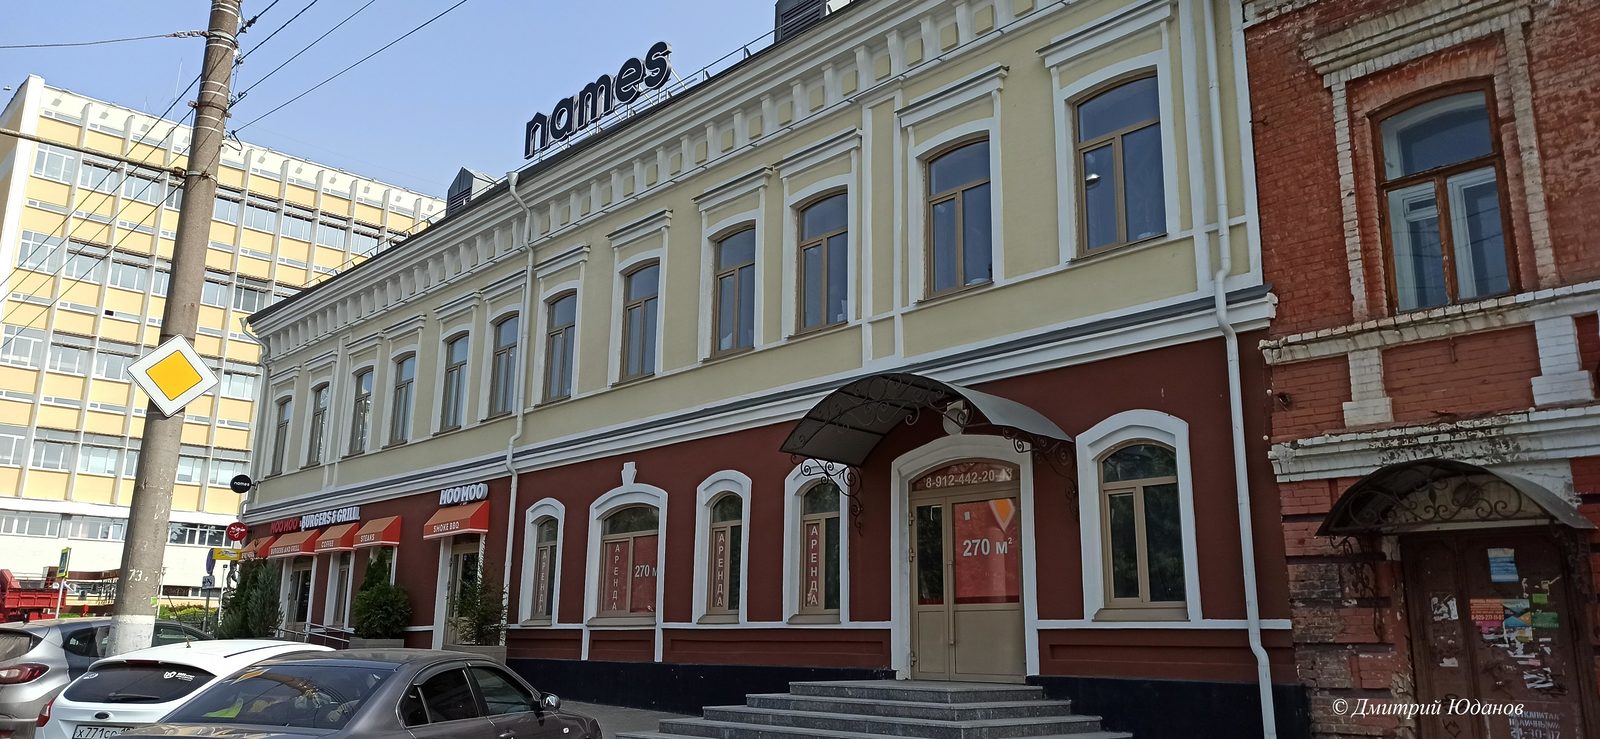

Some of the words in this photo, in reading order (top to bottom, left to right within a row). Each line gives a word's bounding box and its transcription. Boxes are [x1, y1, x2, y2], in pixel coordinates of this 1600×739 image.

[524, 41, 672, 159] names
[433, 522, 449, 533] SMOKE
[320, 540, 335, 548] COFFEE
[360, 533, 375, 542] STEAKS
[963, 538, 990, 557] 270
[634, 564, 650, 578] 270
[716, 533, 725, 607] АРЕНДА
[809, 525, 819, 605] АРЕНДА
[612, 544, 620, 611] АРЕНДА
